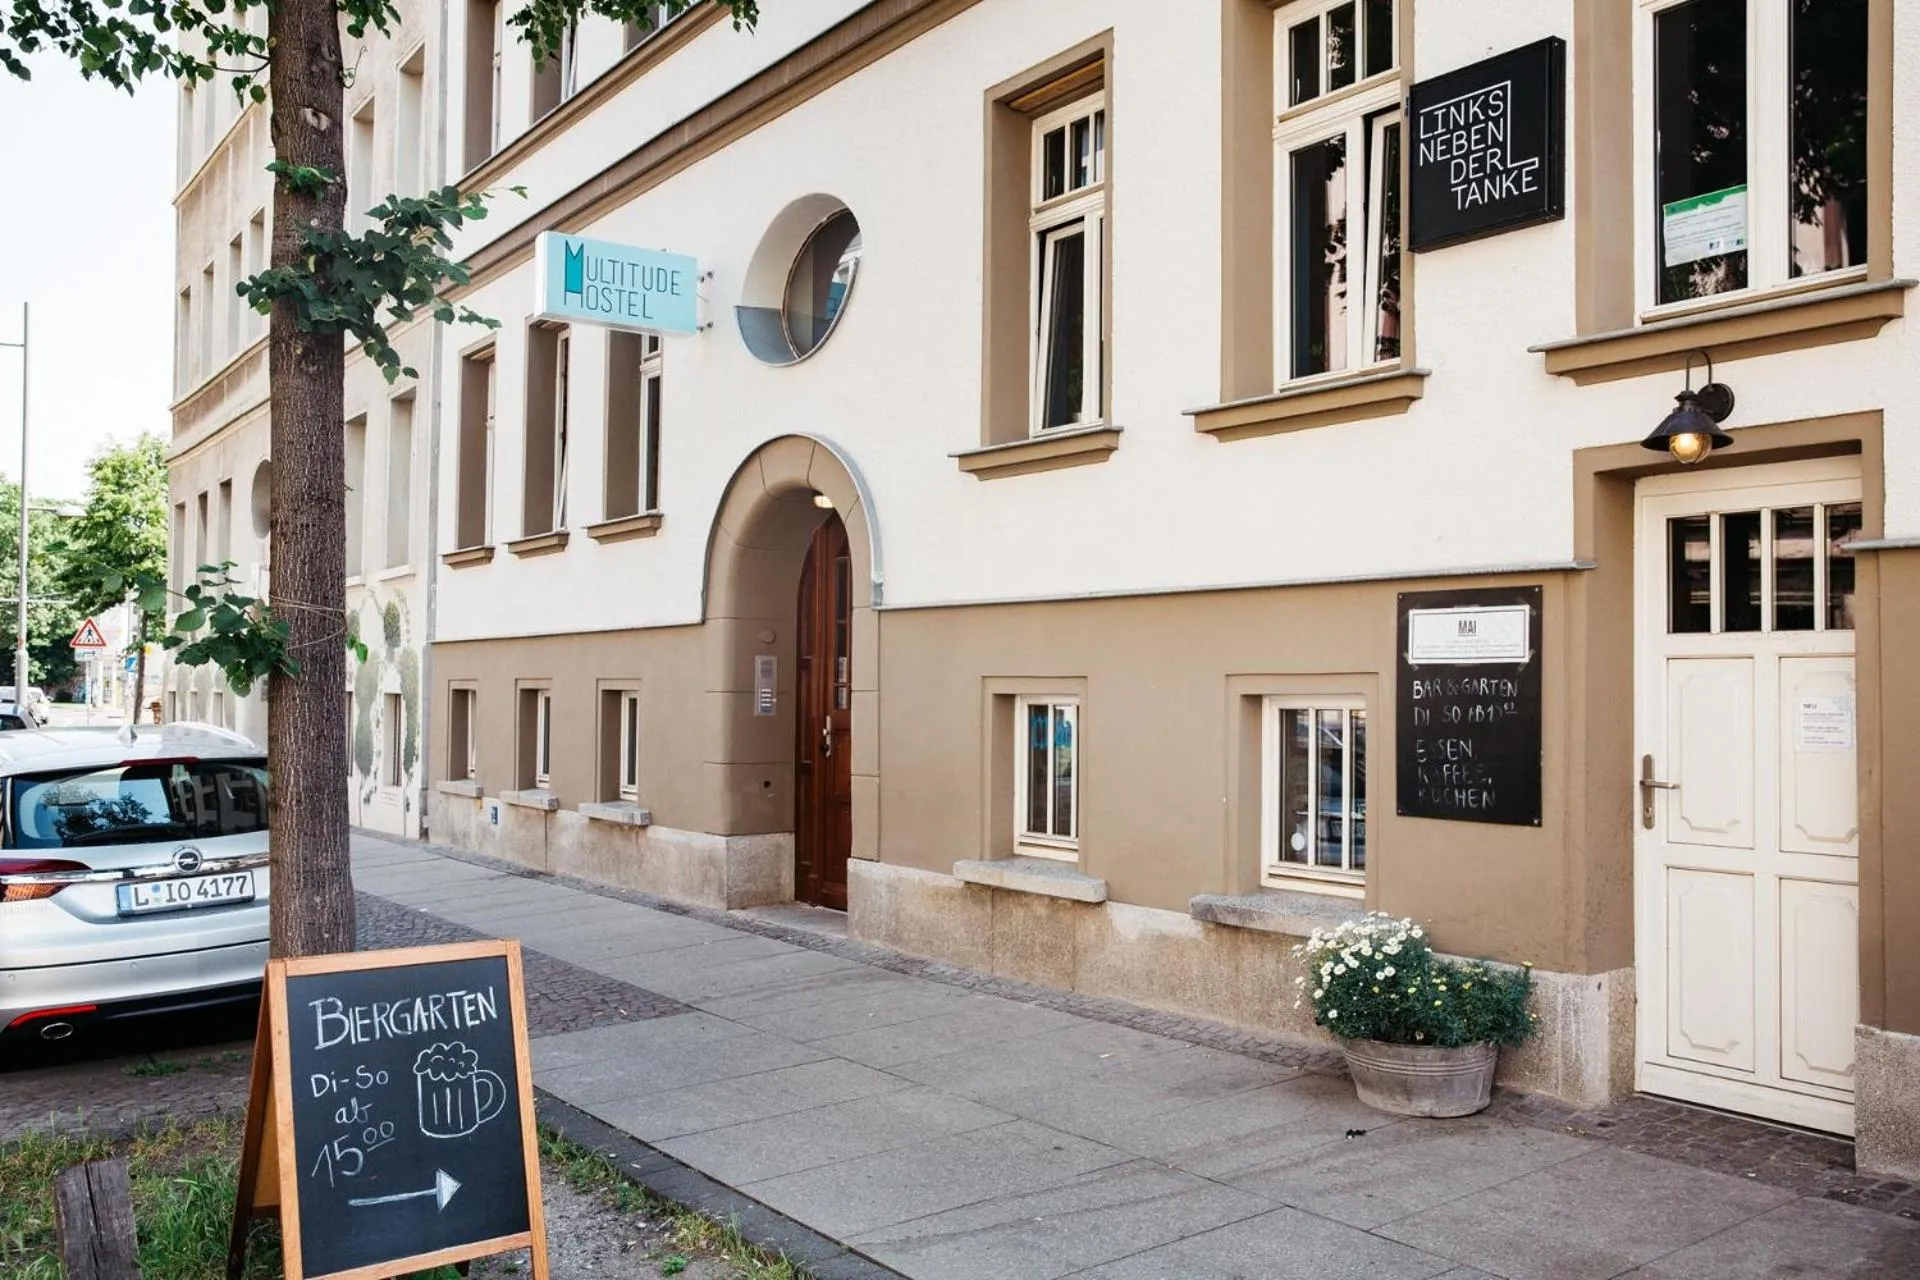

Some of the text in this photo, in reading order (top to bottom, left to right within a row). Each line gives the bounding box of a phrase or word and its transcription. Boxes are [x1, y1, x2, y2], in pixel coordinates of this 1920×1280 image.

[1420, 90, 1504, 139] LINKS
[1419, 117, 1504, 166] NEBEN
[1451, 148, 1504, 185] DER
[1451, 167, 1538, 210] TANKE
[564, 240, 681, 296] MULTITUDE
[1457, 619, 1477, 635] MAI
[1412, 678, 1442, 700] BAR
[1460, 677, 1519, 698] GARTEN
[134, 887, 149, 907] L
[197, 875, 248, 898] 4177
[308, 986, 500, 1051] BIERGARTEN
[310, 1064, 390, 1099] Di-So
[334, 1096, 374, 1125] ab
